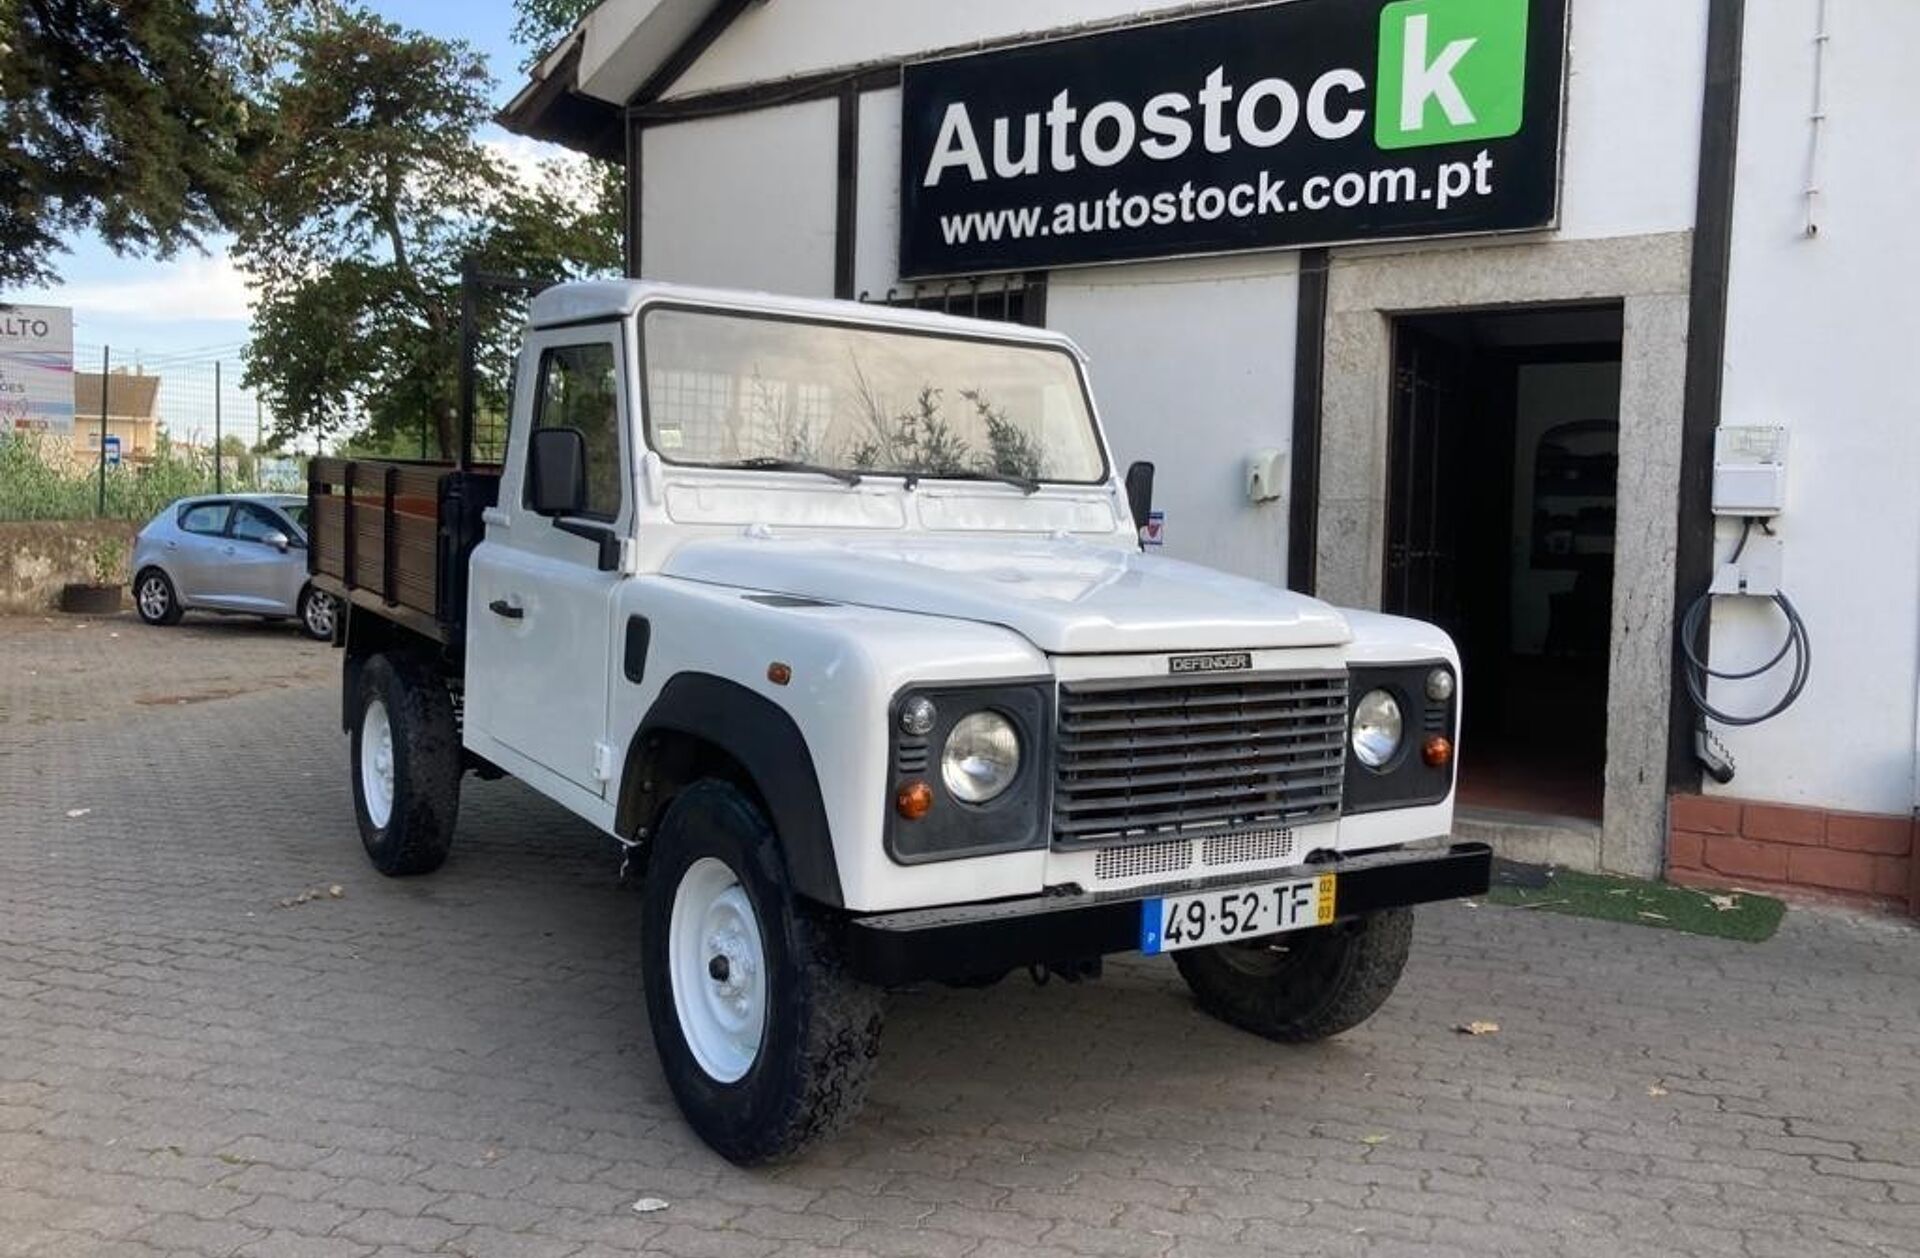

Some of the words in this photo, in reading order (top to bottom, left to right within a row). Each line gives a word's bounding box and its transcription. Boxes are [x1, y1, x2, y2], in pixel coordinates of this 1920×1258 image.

[923, 13, 1476, 187] Autostock
[941, 150, 1493, 244] www.autostock.com.pt
[1172, 653, 1248, 672] DEFENDER
